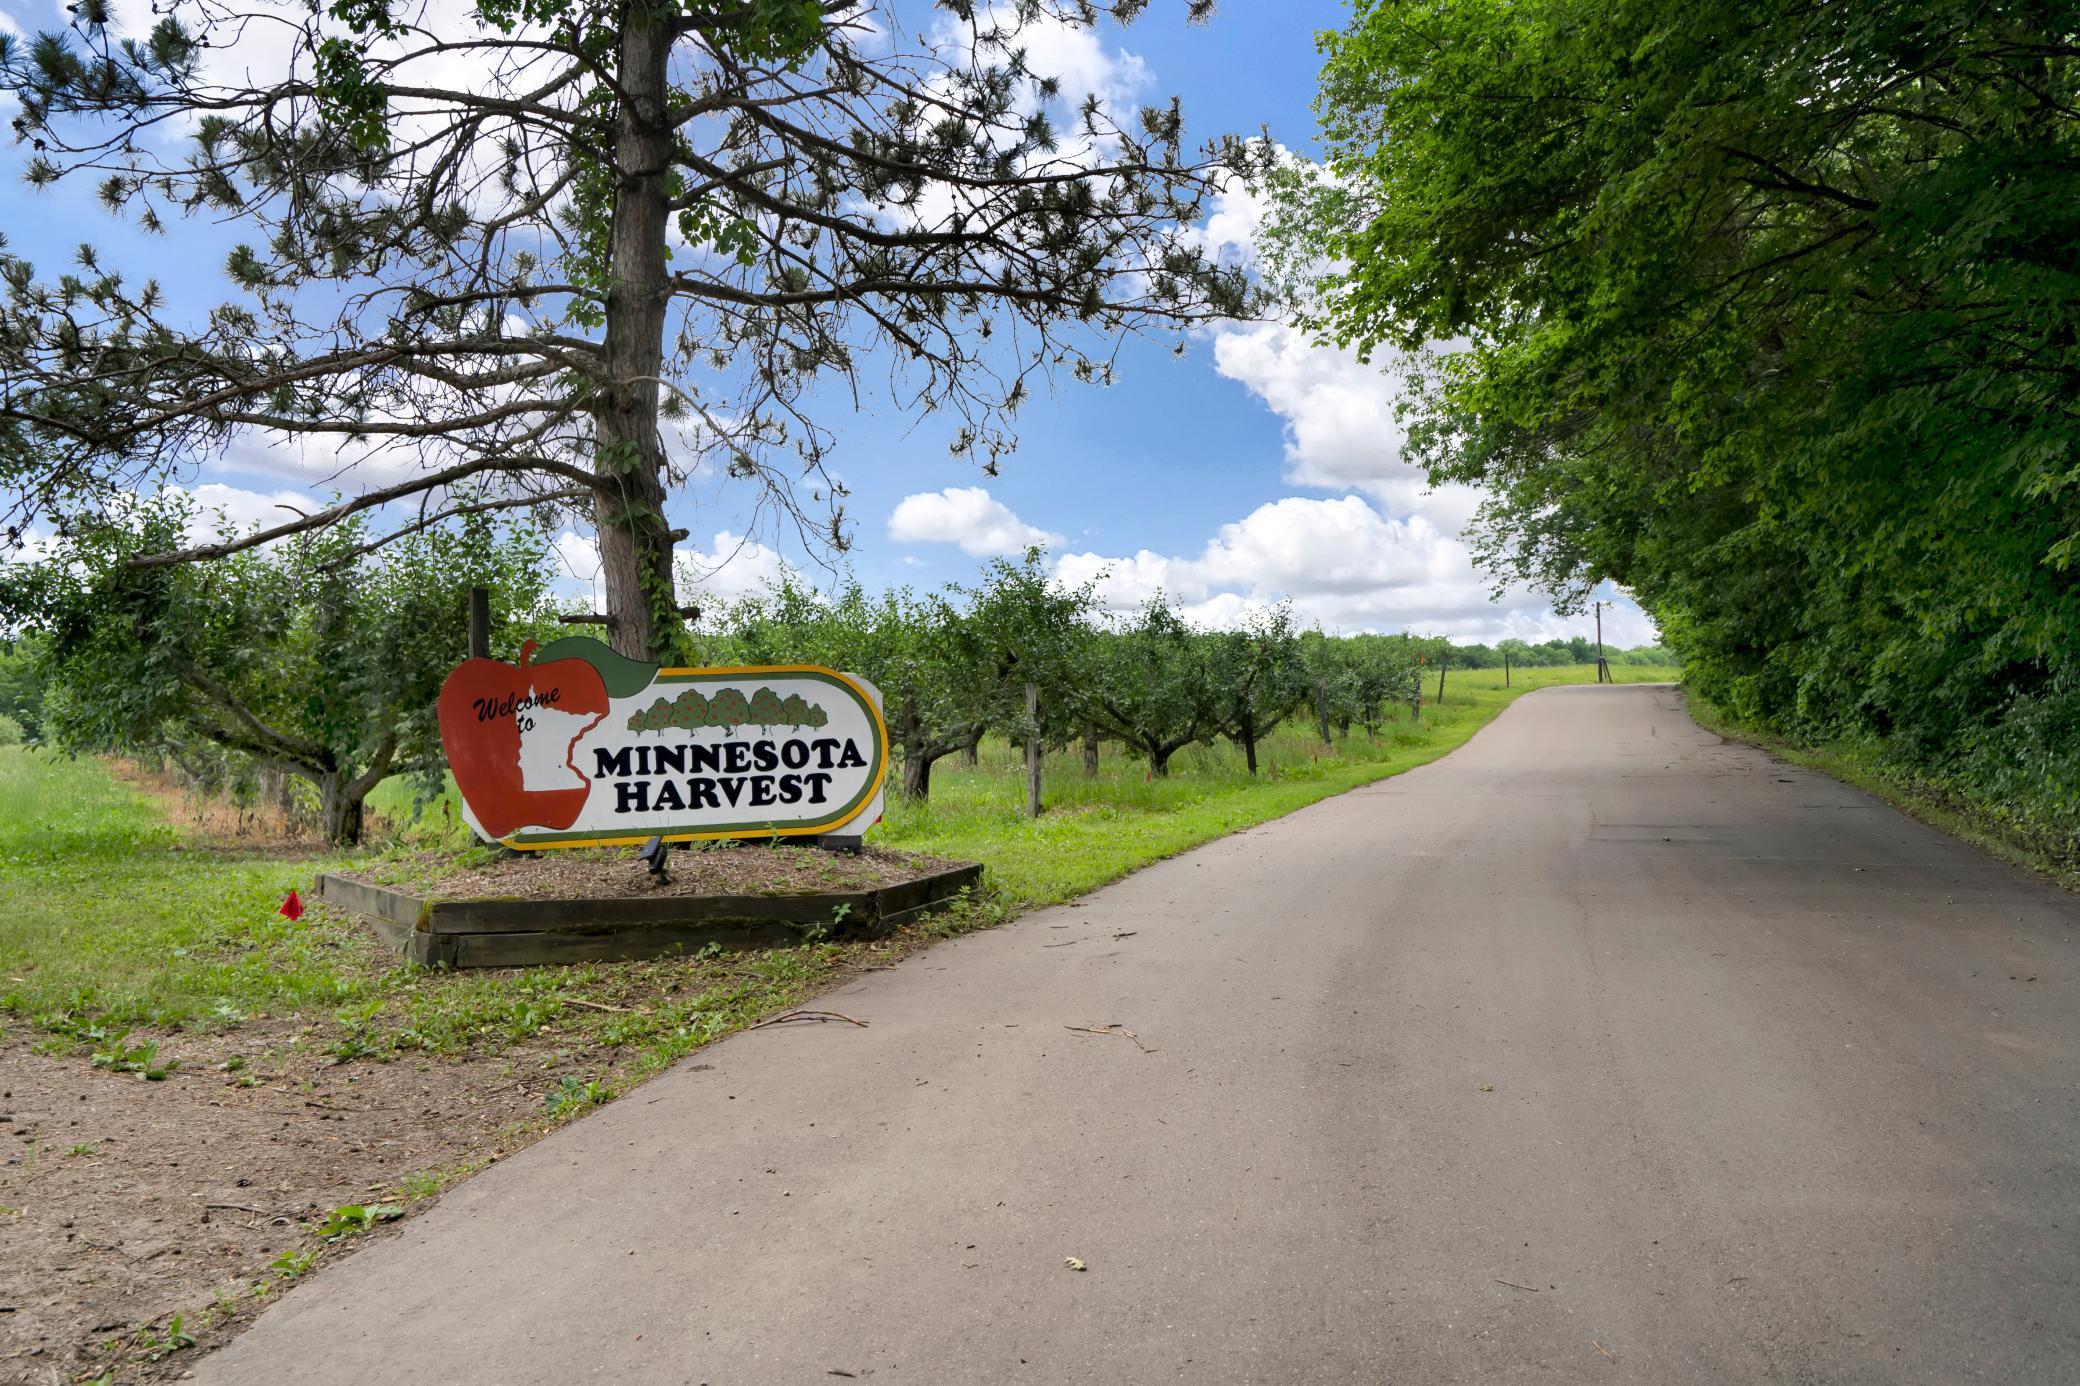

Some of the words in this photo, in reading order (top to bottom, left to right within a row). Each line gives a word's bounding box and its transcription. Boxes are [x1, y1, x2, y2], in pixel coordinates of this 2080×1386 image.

[472, 687, 561, 722] Welcome
[517, 714, 536, 734] to
[593, 738, 867, 778] MINNESOTA
[614, 773, 832, 813] HARVEST
